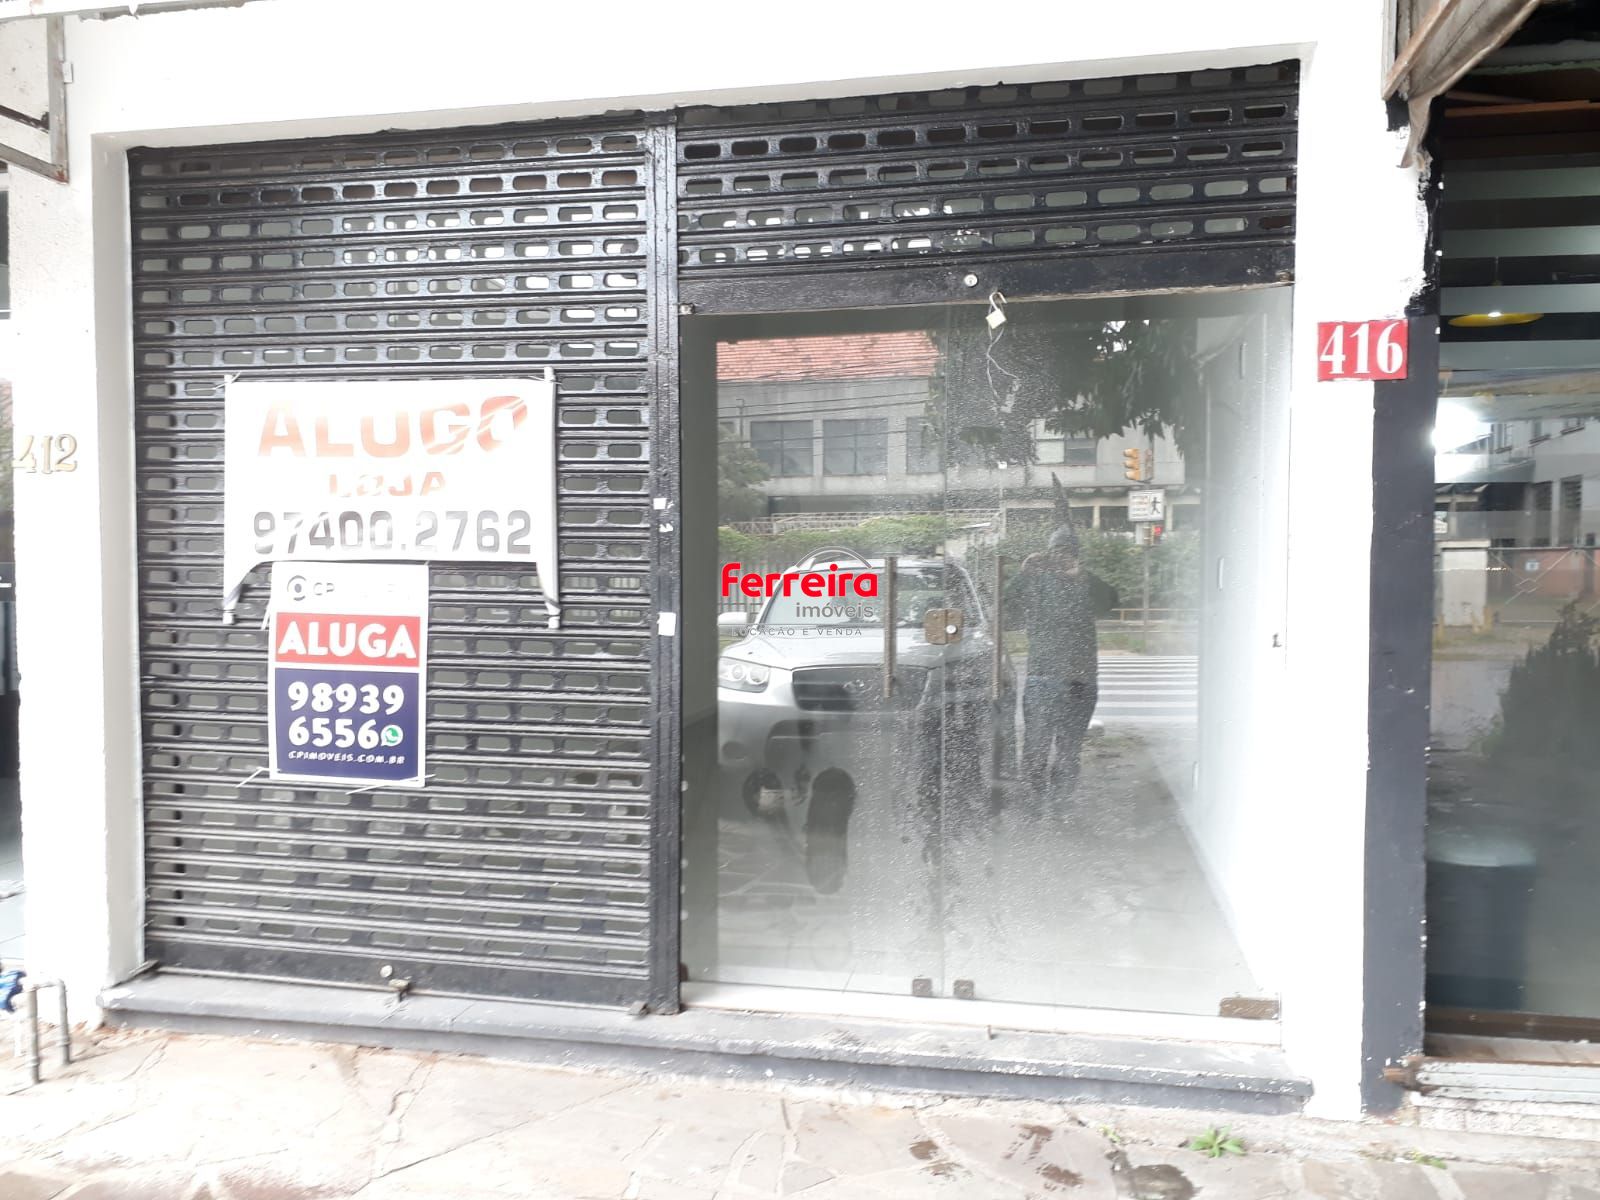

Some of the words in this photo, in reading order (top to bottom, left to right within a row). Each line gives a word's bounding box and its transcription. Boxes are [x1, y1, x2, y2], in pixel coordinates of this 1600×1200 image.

[1320, 321, 1403, 374] 416
[257, 395, 528, 458] ALUGO
[12, 433, 78, 475] 412
[329, 471, 447, 498] LOJA
[253, 510, 532, 555] 97400.2762
[278, 620, 416, 659] ALUGA
[287, 681, 405, 715] 98939
[288, 716, 380, 749] 6556
[287, 750, 406, 765] CPIMOVEIS.COM.BR
